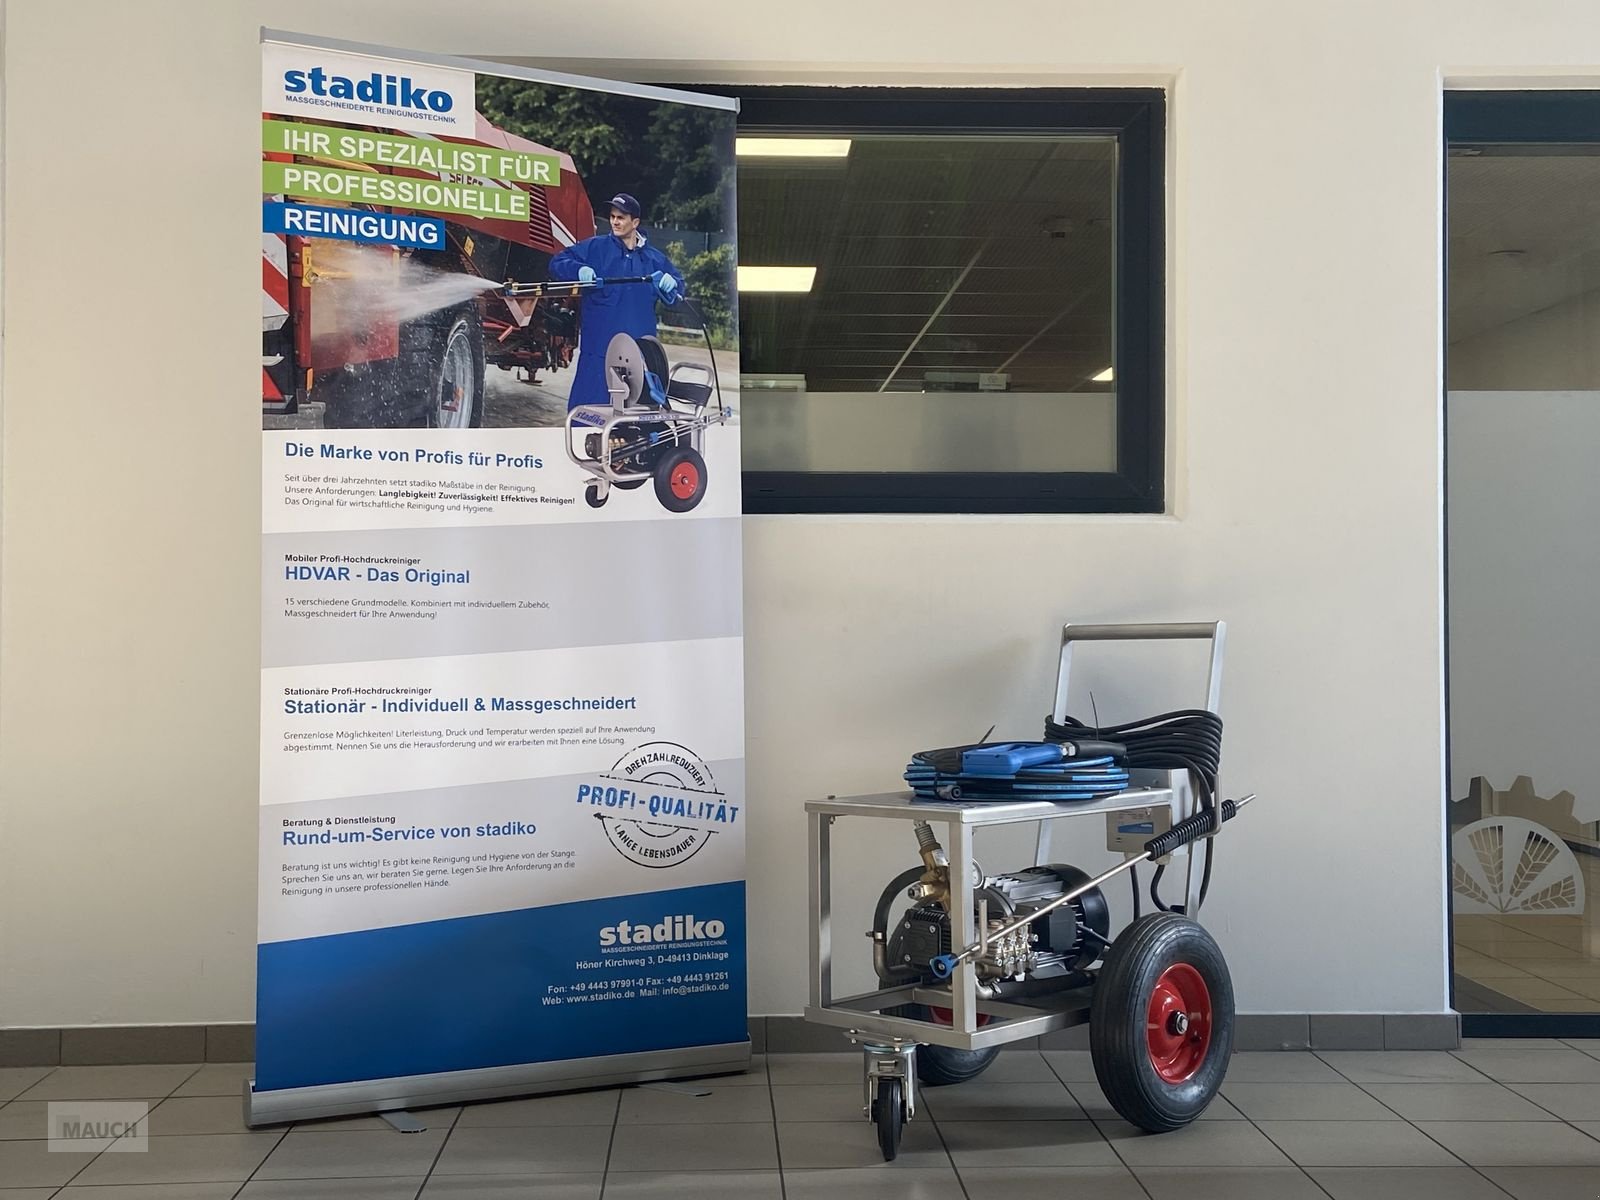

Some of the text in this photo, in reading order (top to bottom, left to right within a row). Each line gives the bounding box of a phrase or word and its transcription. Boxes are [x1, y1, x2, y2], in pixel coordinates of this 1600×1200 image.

[284, 66, 453, 113] stadiko
[285, 95, 456, 124] MASSGESCHNEIDERTE REINIGUNGSTECHNIK
[284, 129, 331, 155] IHR
[339, 136, 492, 174] SPEZIALIST
[500, 155, 551, 182] FÜR
[284, 168, 525, 216] PROFESSIONELLE
[284, 208, 438, 244] REINIGUNG
[285, 442, 543, 469] Die Marke von Profis für Profis
[284, 474, 300, 483] Seit
[302, 474, 320, 483] über
[323, 475, 338, 483] drei
[340, 476, 387, 486] Jahrzehnten
[389, 478, 407, 487] setzt
[409, 478, 437, 488] stadiko
[438, 480, 474, 490] Maßstäbe
[476, 482, 483, 490] in
[485, 482, 497, 491] der
[284, 486, 575, 506] Unsere Anforderungen: Langlebigkeit! Zuverlässigkeit! Effektives Reinigen!
[284, 497, 300, 506] Das
[302, 497, 334, 508] Original
[336, 498, 347, 507] für
[349, 500, 405, 510] wirtschaftliche
[407, 502, 444, 511] Reinigung
[447, 503, 460, 511] und
[284, 554, 421, 566] Mobiler Profi-Hochdruckreiniger
[285, 566, 350, 581] HDVAR
[367, 568, 399, 582] Das
[405, 568, 470, 587] Original
[285, 598, 295, 606] 15
[297, 598, 349, 607] verschiedene
[351, 598, 409, 607] Grundmodelle.
[411, 600, 452, 608] Kombiniert
[454, 600, 466, 608] mit
[468, 600, 517, 609] individuellem
[284, 610, 437, 620] Massgeschneidert für Ihre Anwendung!
[284, 687, 432, 697] Stationäre Profi-Hochdruckreiniger
[284, 698, 366, 714] Stationär
[382, 697, 468, 713] Individuell
[474, 697, 486, 711] &
[491, 696, 636, 714] Massgeschneidert
[284, 731, 334, 740] Grenzenlose
[336, 730, 394, 741] Möglichkeiten!
[445, 728, 467, 737] Druck
[469, 727, 483, 736] und
[486, 727, 528, 737] Temperatur
[529, 727, 556, 735] werden
[558, 726, 583, 736] speziell
[585, 726, 597, 734] auf
[599, 726, 611, 734] Ihre
[613, 725, 656, 735] Anwendung
[337, 742, 367, 750] Nennen
[370, 741, 382, 750] Sie
[399, 741, 411, 749] die
[413, 740, 476, 750] Herausforderung
[478, 739, 492, 748] und
[494, 739, 506, 747] wir
[508, 738, 545, 746] erarbeiten
[546, 738, 558, 746] mit
[560, 737, 580, 746] Ihnen
[582, 737, 597, 745] eine
[625, 752, 706, 787] DREHZAHLREDUZIERT
[576, 784, 739, 824] PROFI-QUALITÄT
[282, 816, 396, 828] Beratung & Dienstleistung
[283, 821, 537, 846] Rund-um-Service von stadiko
[614, 824, 696, 859] LANGE LEBENSDAUER
[282, 863, 319, 873] Beratung
[322, 862, 331, 870] ist
[350, 859, 380, 869] wichtig!
[383, 859, 391, 867] Es
[393, 858, 408, 867] gibt
[411, 857, 430, 866] keine
[433, 854, 470, 865] Reinigung
[472, 854, 487, 862] und
[489, 853, 520, 863] Hygiene
[521, 852, 535, 860] von
[537, 851, 549, 859] der
[282, 874, 320, 885] Sprechen
[322, 874, 334, 882] Sie
[336, 874, 351, 882] uns
[366, 872, 378, 880] wir
[380, 870, 410, 879] beraten
[412, 869, 423, 877] Sie
[451, 866, 474, 876] Legen
[476, 865, 488, 874] Sie
[489, 864, 504, 873] Ihre
[505, 863, 552, 873] Anforderung
[282, 887, 323, 897] Reinigung
[363, 882, 421, 892] professionellen
[599, 914, 725, 946] stadiko
[601, 939, 727, 954] MASSGESCHNEIDERTE REINIGUNGSTECHNIK
[576, 951, 729, 970] Höner Kirchweg 3, D-49413 Dinklage
[547, 971, 729, 994] Fon: +49 4443 97991-0 Fax: +49 4443 91261
[542, 983, 730, 1006] Web: www.stadiko.de Mail: info@stadiko.de
